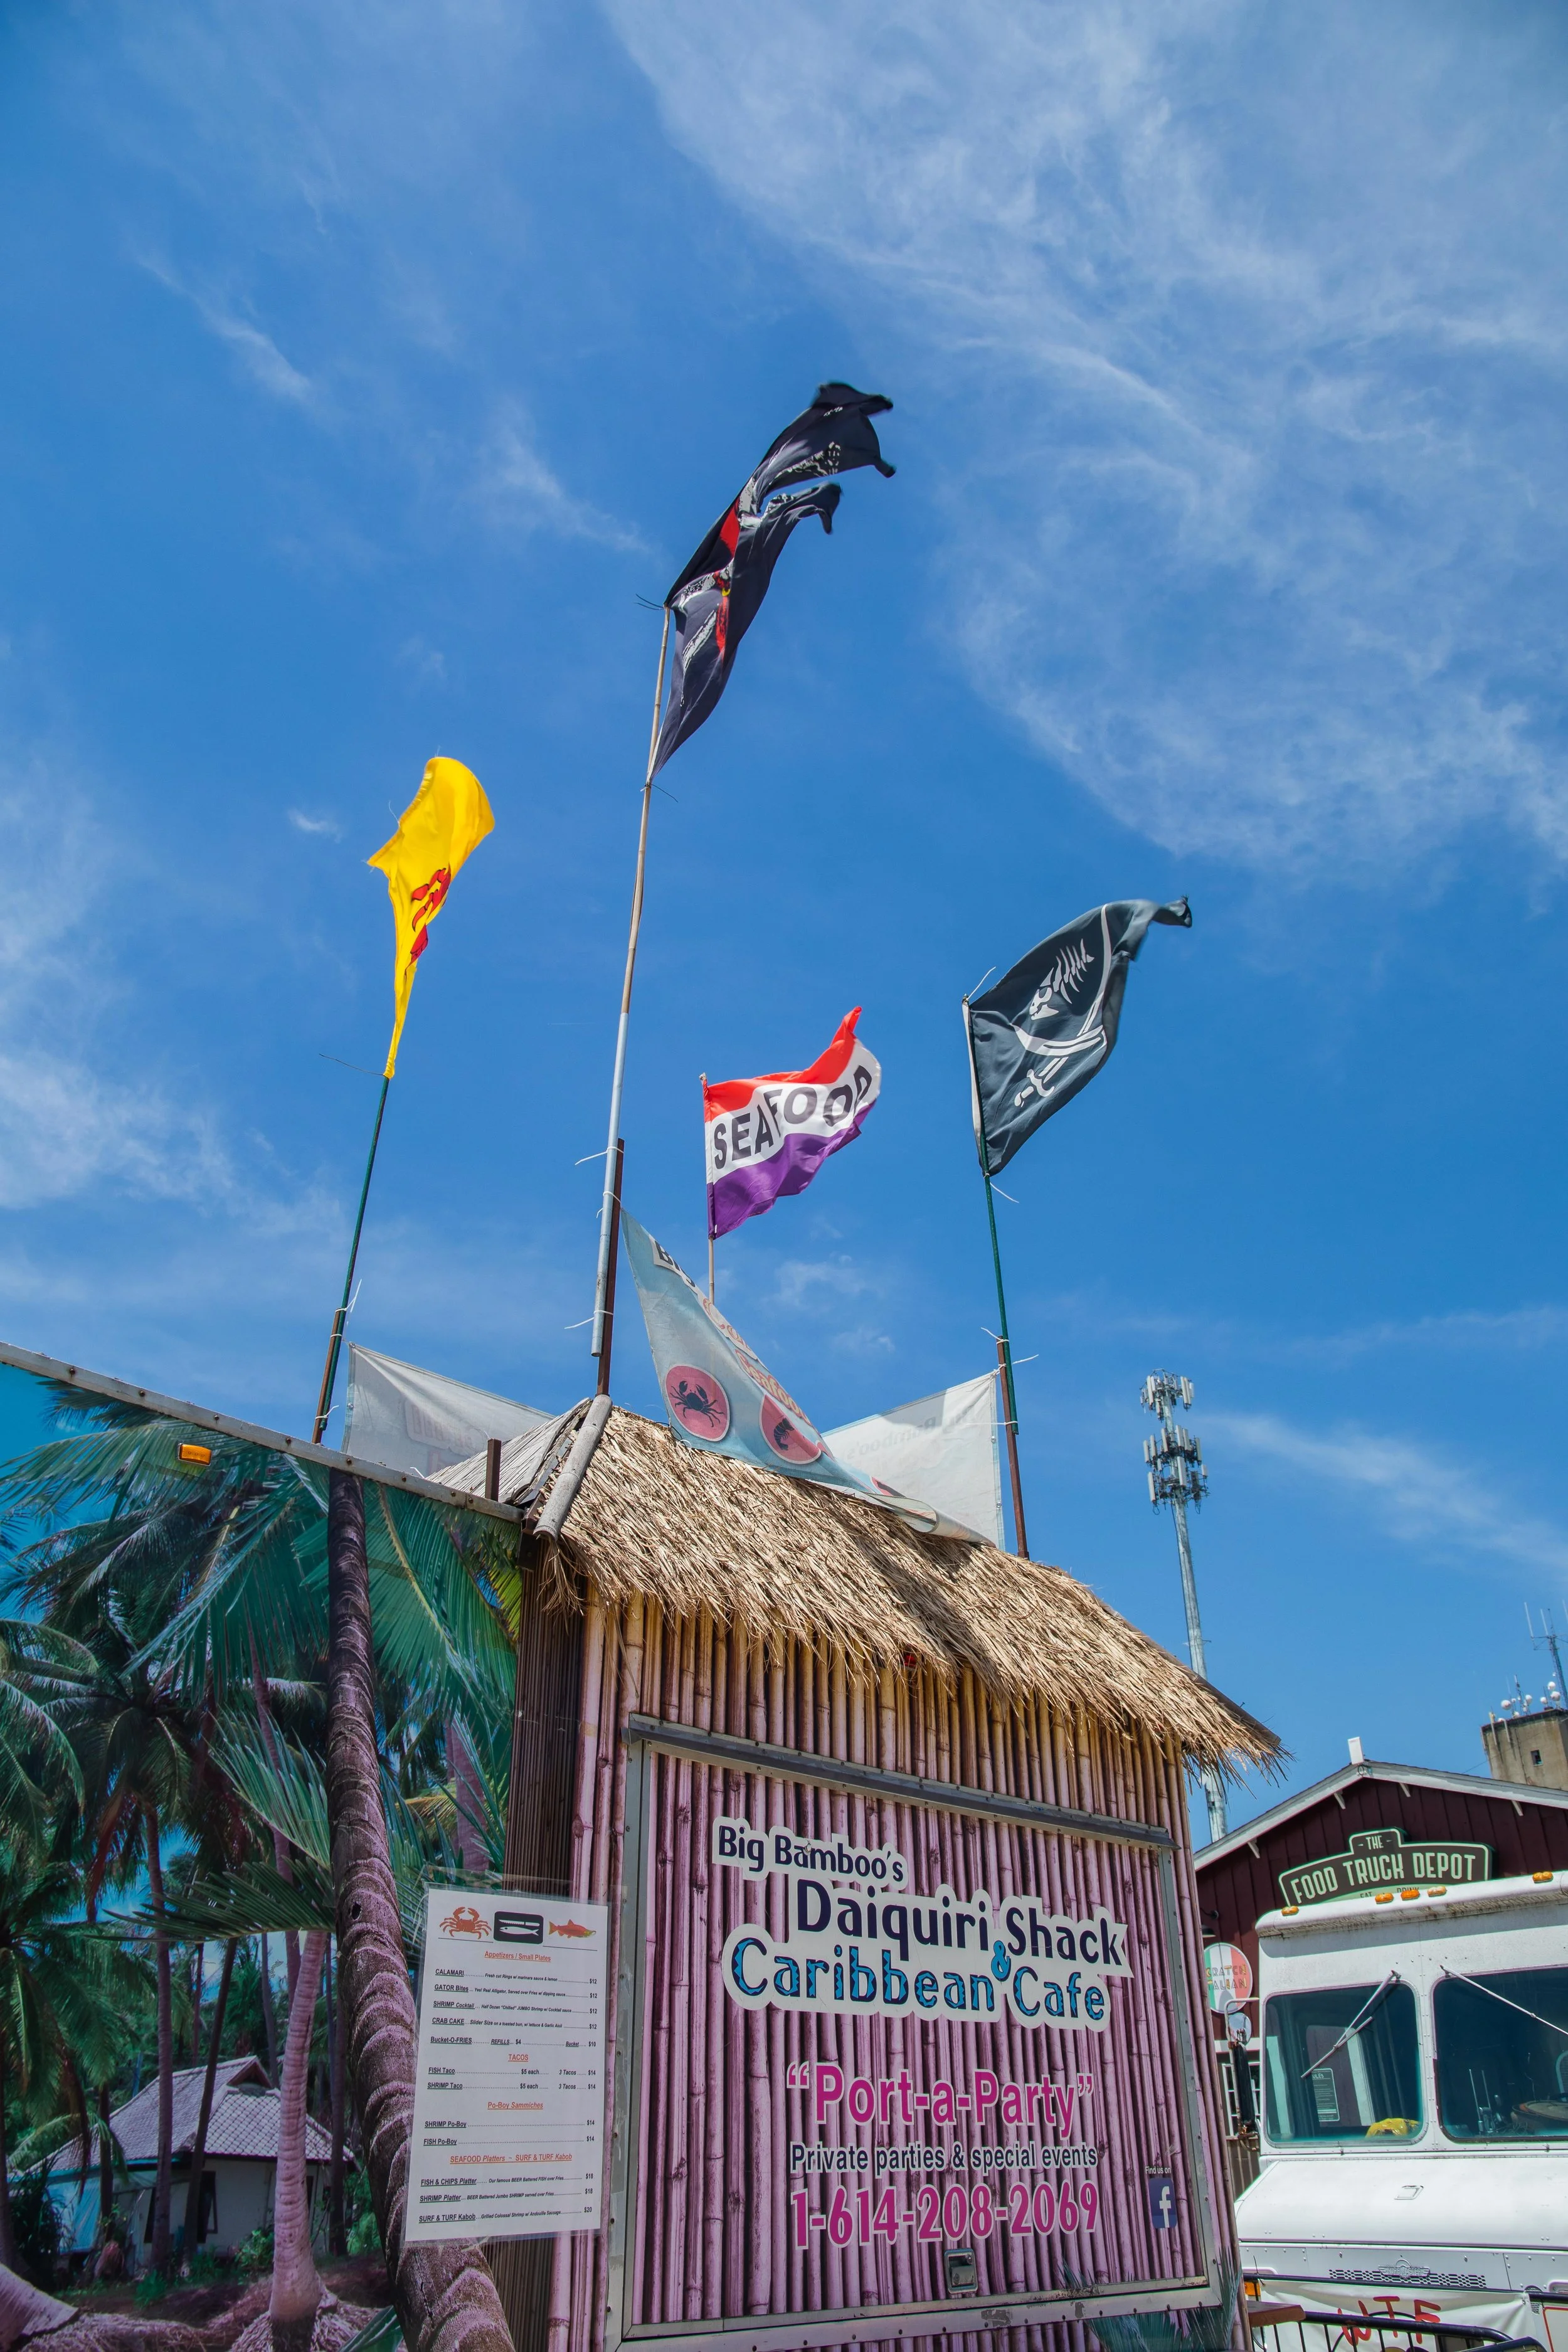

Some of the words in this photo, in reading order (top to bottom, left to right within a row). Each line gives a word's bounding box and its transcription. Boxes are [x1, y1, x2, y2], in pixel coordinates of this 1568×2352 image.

[714, 1065, 872, 1170] SEAFOOD
[719, 1825, 765, 1873] Big
[775, 1834, 904, 1882] Bamboo's
[1366, 1835, 1384, 1850] THE
[1291, 1867, 1338, 1904] FOOD
[1343, 1853, 1404, 1886] TRUCK
[1413, 1853, 1476, 1880] DEPOT
[797, 1880, 989, 1961] Daiquiri
[1006, 1906, 1122, 1966] Shack
[731, 1937, 994, 2012] Caribbean
[991, 1939, 1011, 1979] &
[1014, 1966, 1104, 2020] Cafe
[1205, 1964, 1246, 1977] CRATCH
[1207, 1978, 1247, 1990] TALIAN
[787, 2061, 1094, 2139] “Port-a-Party”
[792, 2144, 869, 2174] Private
[876, 2143, 946, 2178] parties
[953, 2145, 965, 2168] &
[971, 2141, 1036, 2175] special
[1042, 2144, 1098, 2169] events
[791, 2180, 1098, 2249] 1-614-208-2069
